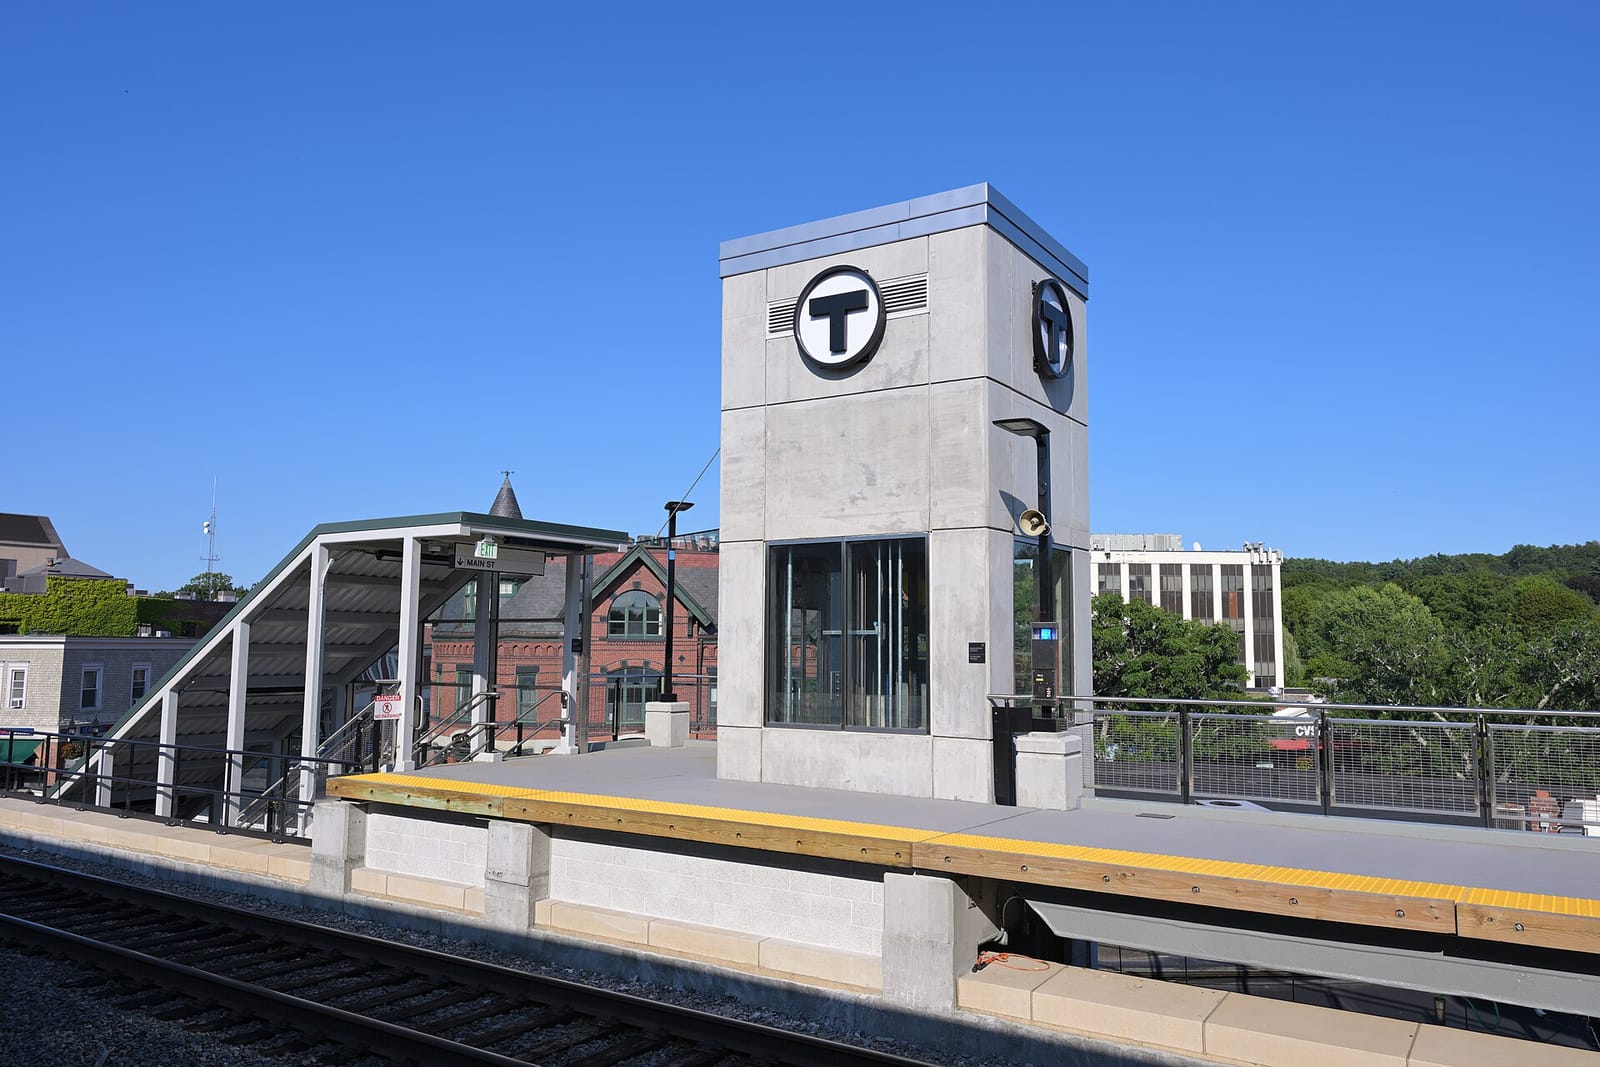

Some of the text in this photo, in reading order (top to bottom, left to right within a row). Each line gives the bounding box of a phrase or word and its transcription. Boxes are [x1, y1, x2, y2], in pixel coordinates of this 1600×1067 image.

[809, 289, 869, 353] T
[1041, 299, 1067, 365] T
[466, 559, 485, 568] MAIN
[480, 543, 495, 557] EXIT
